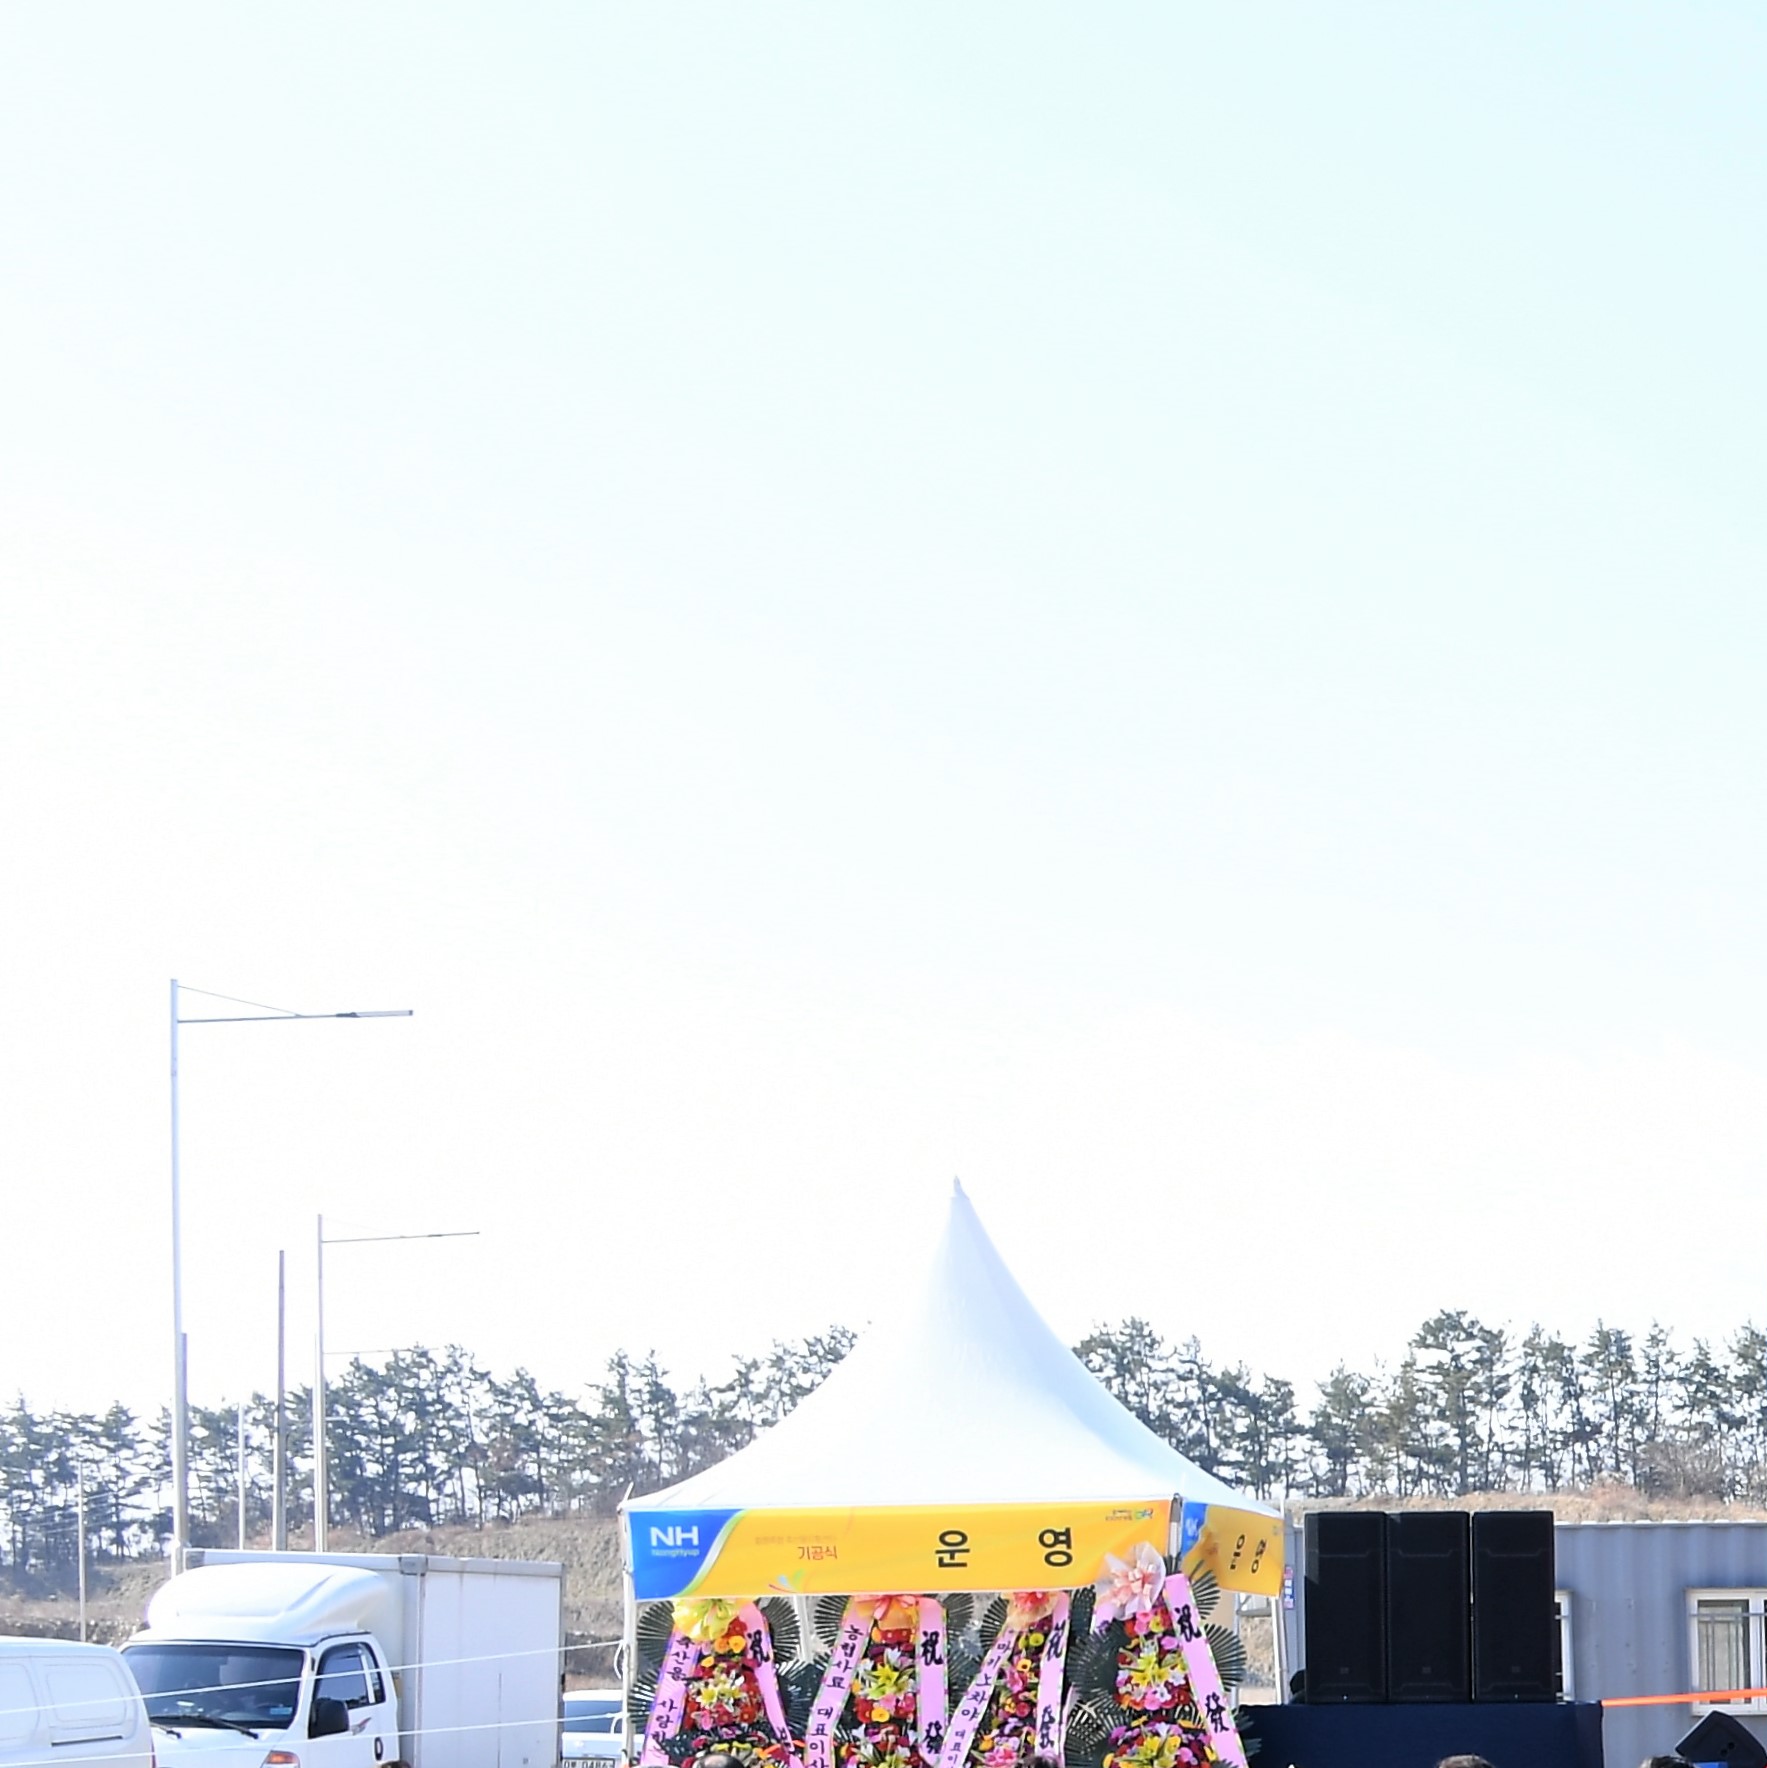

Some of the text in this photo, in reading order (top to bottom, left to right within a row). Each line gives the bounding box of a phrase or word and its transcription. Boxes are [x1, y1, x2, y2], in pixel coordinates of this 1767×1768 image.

[650, 1525, 699, 1547] NH
[796, 1545, 838, 1561] 기공식
[934, 1527, 1073, 1568] 운 영
